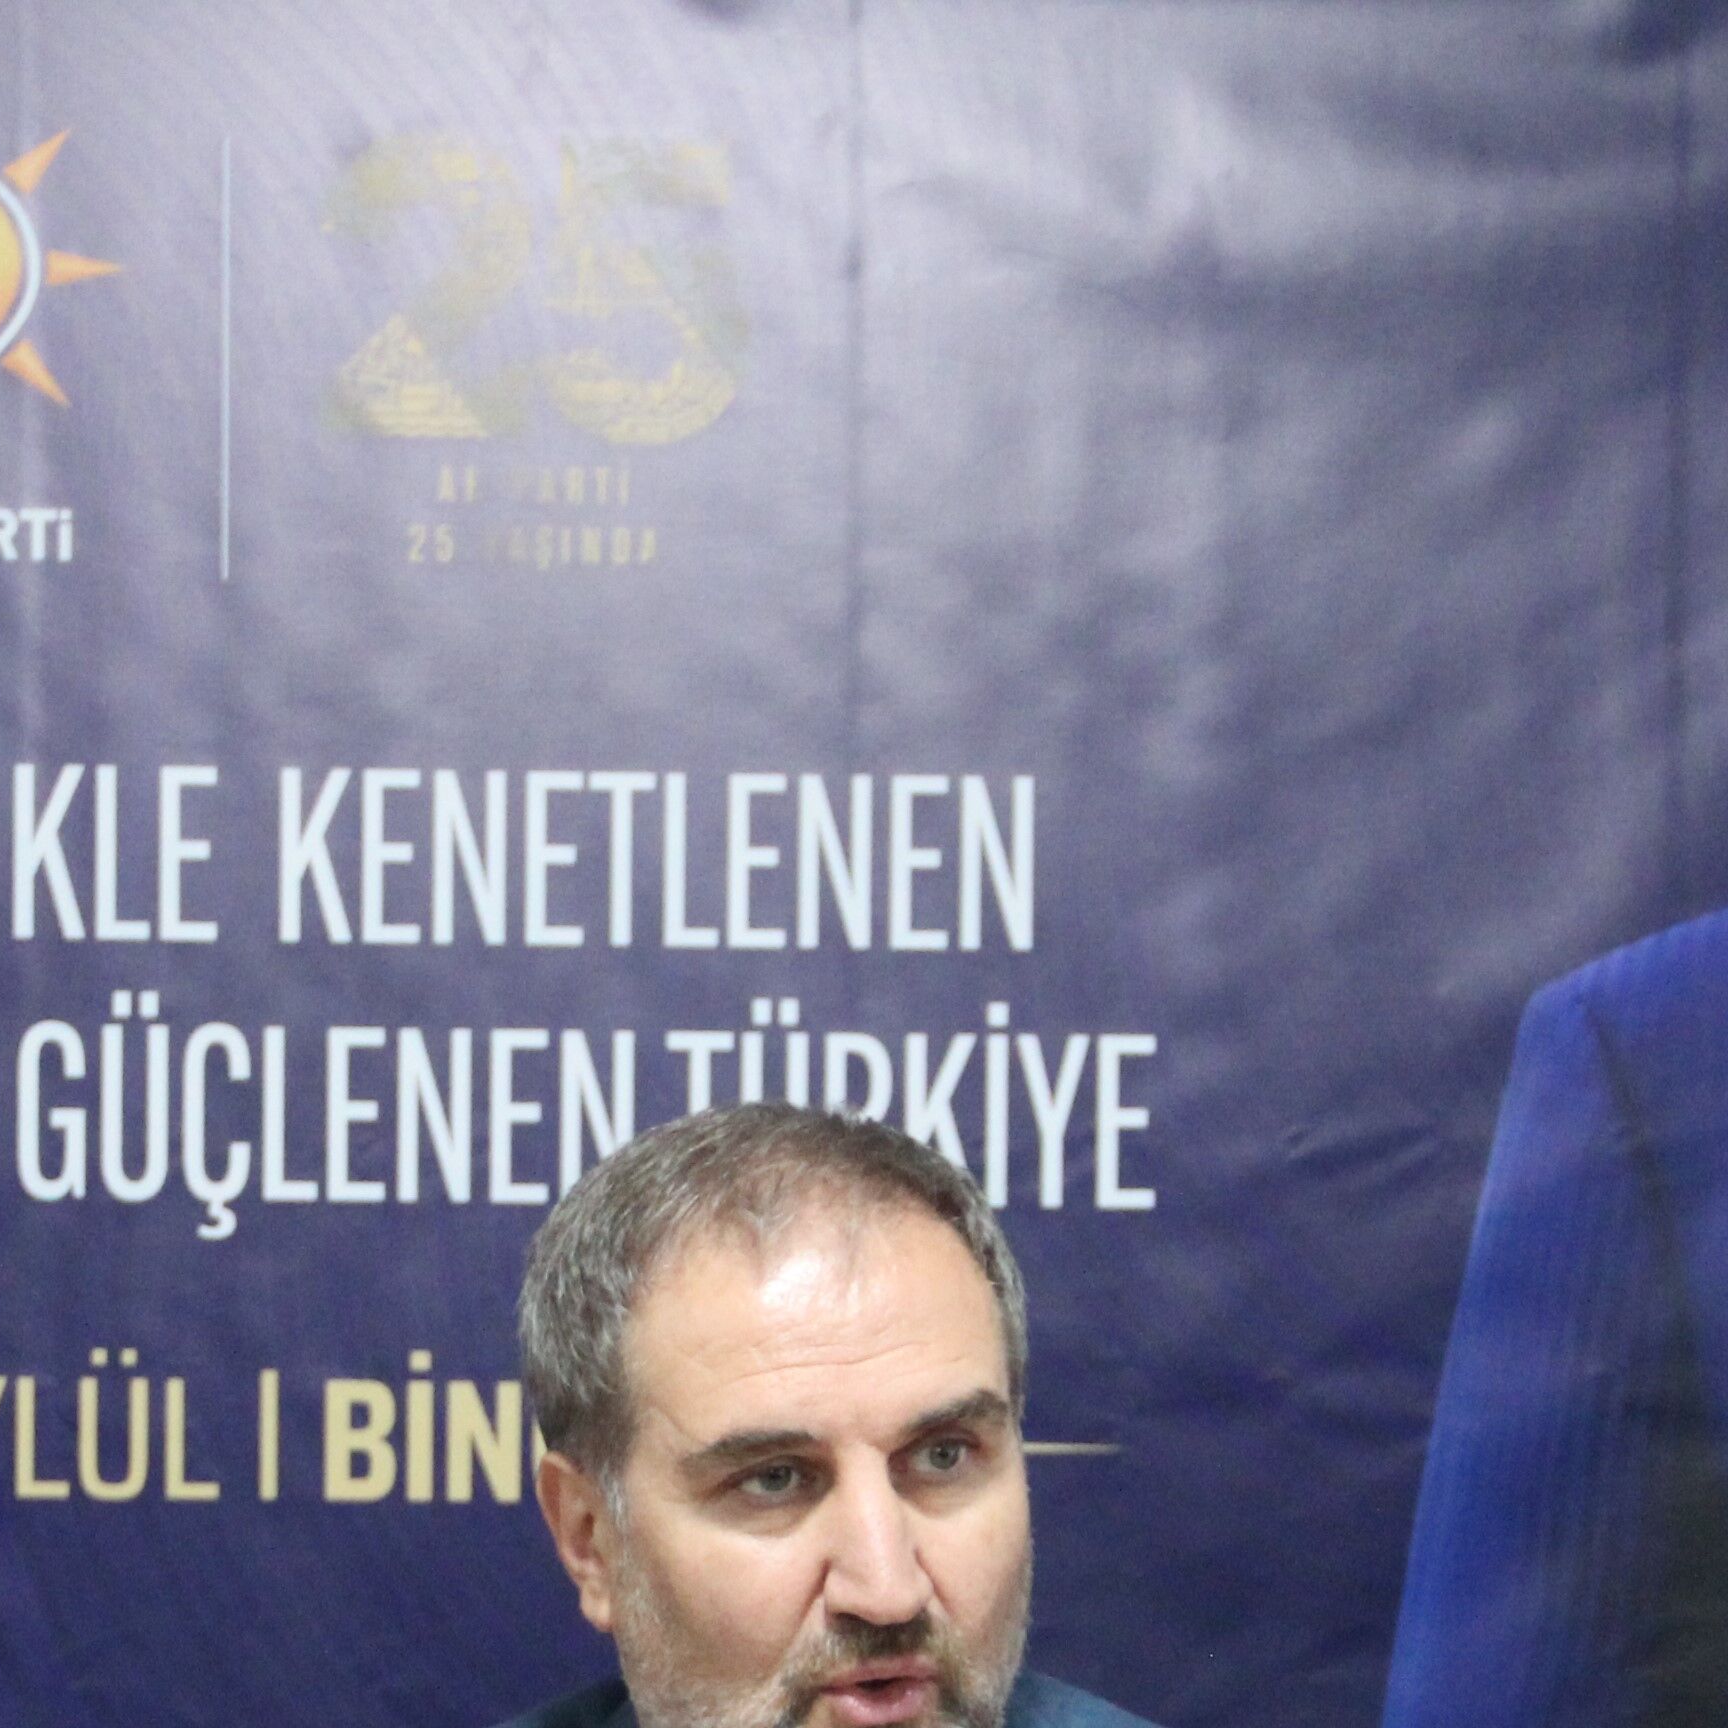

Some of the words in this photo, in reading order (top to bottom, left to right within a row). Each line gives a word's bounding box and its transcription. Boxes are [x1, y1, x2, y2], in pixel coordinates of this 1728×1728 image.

[282, 768, 1037, 954] KENETLENEN
[18, 991, 636, 1240] GÜÇLENEN
[323, 1349, 548, 1505] BİN
